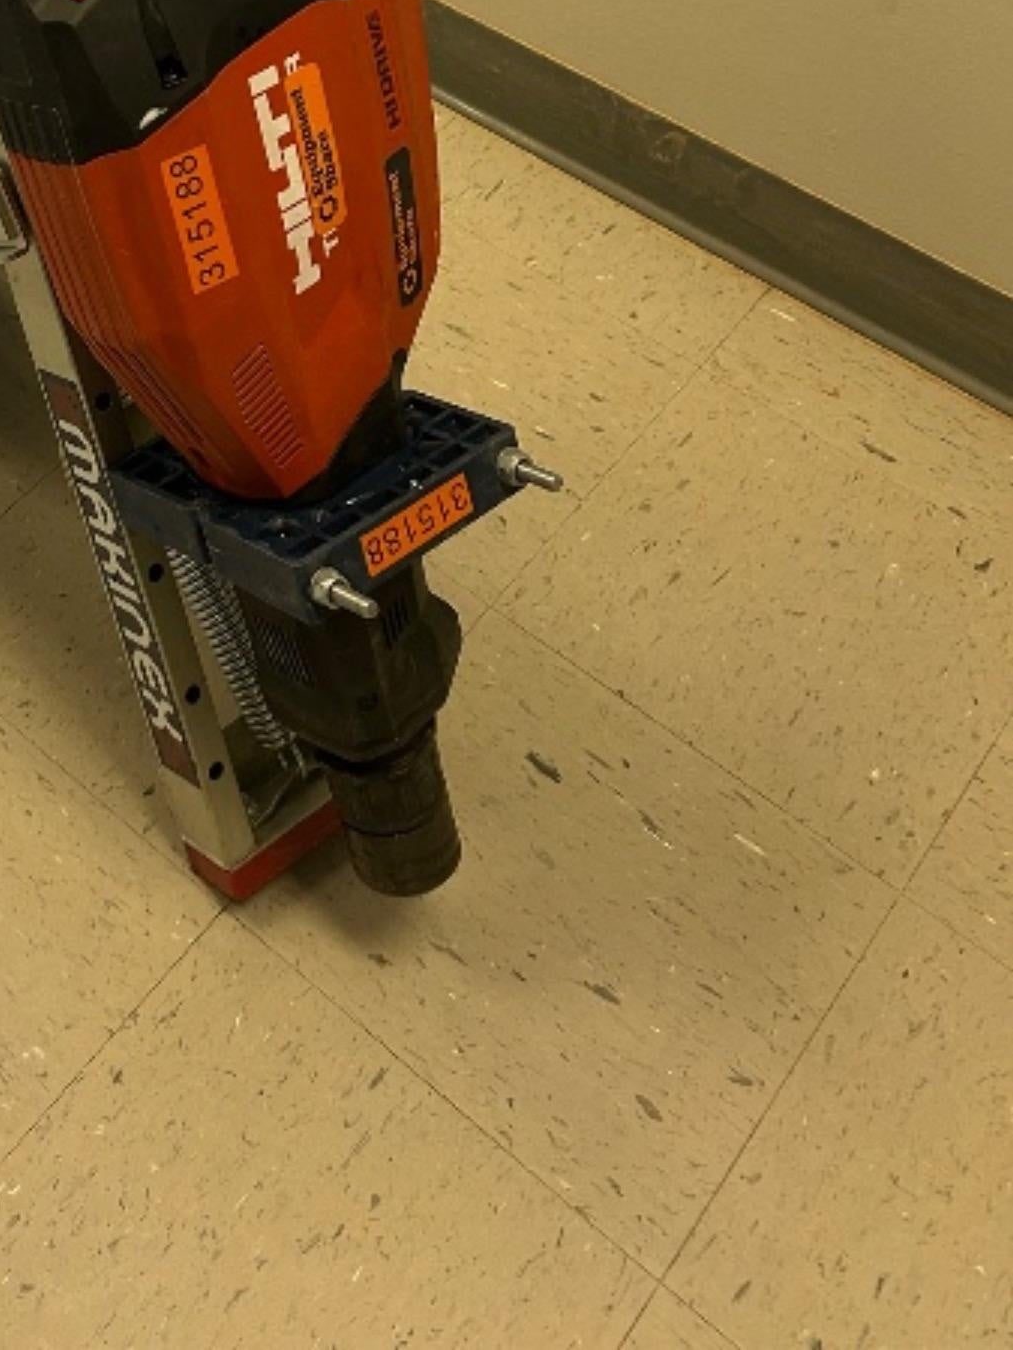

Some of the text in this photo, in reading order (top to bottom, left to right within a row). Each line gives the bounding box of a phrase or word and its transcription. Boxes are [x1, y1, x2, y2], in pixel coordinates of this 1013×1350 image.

[168, 153, 227, 287] 315188
[248, 65, 322, 296] HILTI
[57, 418, 185, 745] MAKINEX
[366, 480, 470, 566] 315188
